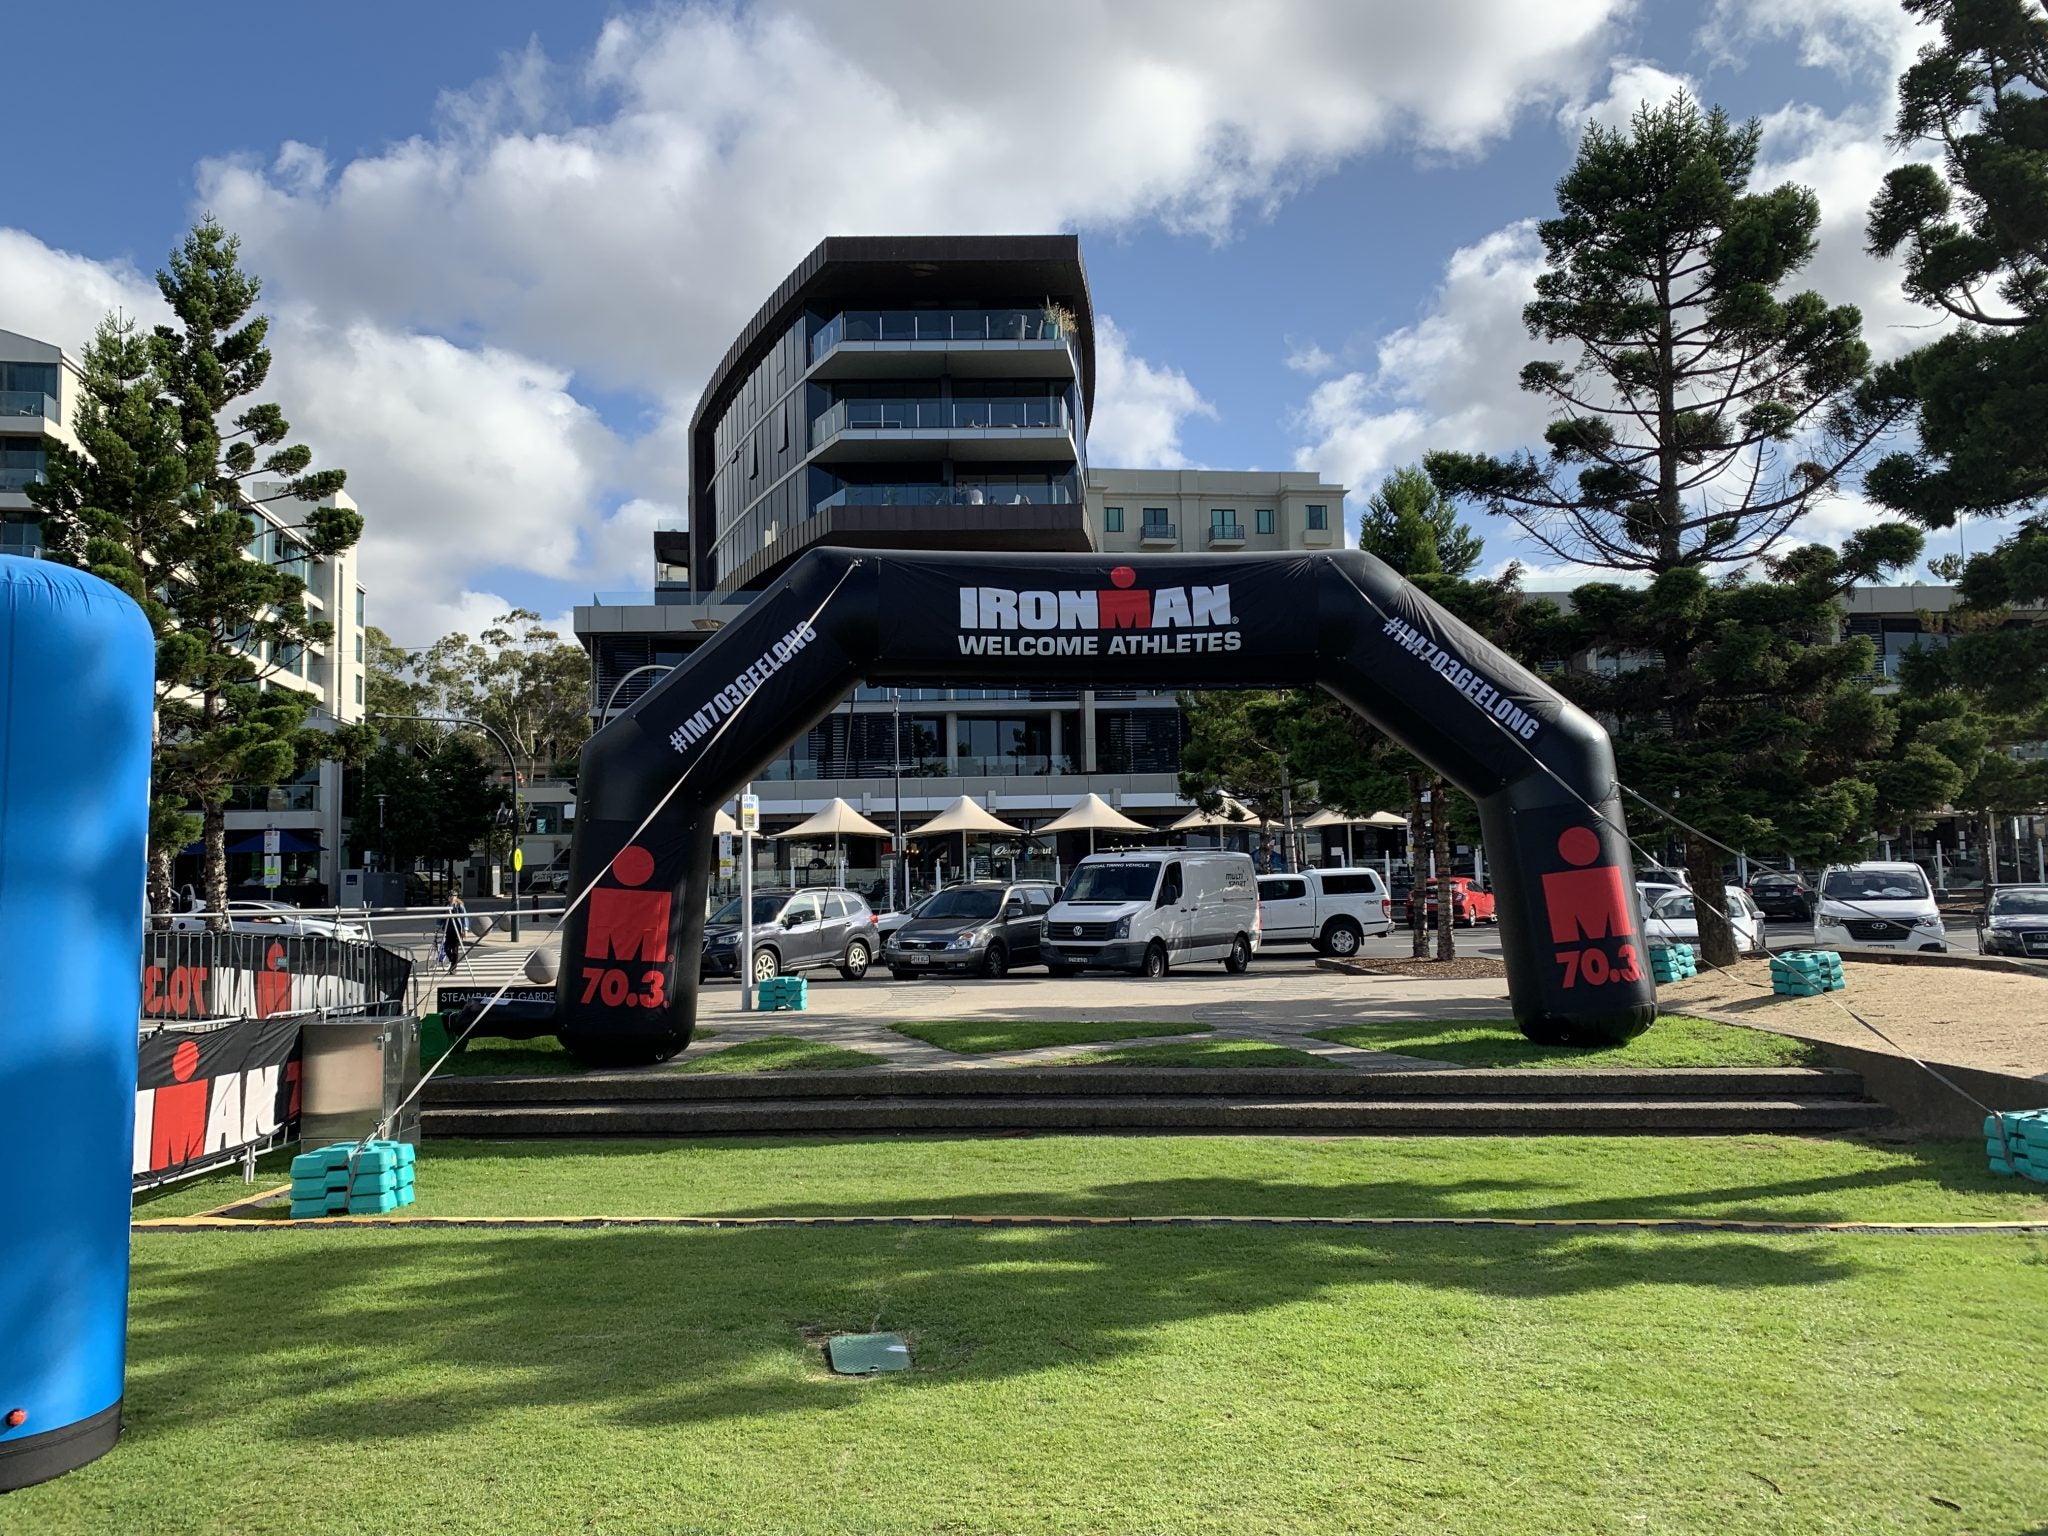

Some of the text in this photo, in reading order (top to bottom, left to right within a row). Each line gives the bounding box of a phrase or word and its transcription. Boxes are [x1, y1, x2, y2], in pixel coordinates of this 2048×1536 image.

[959, 566, 1231, 630] IRONMAN
[958, 631, 1242, 656] WELCOME ATHLETES
[669, 620, 817, 754] #IM703GEELONG
[1382, 616, 1540, 740] #IM703GEELONG
[580, 967, 665, 1008] 70.3
[1555, 943, 1641, 989] 70.3
[441, 991, 557, 1002] STEAMPACET GARDE
